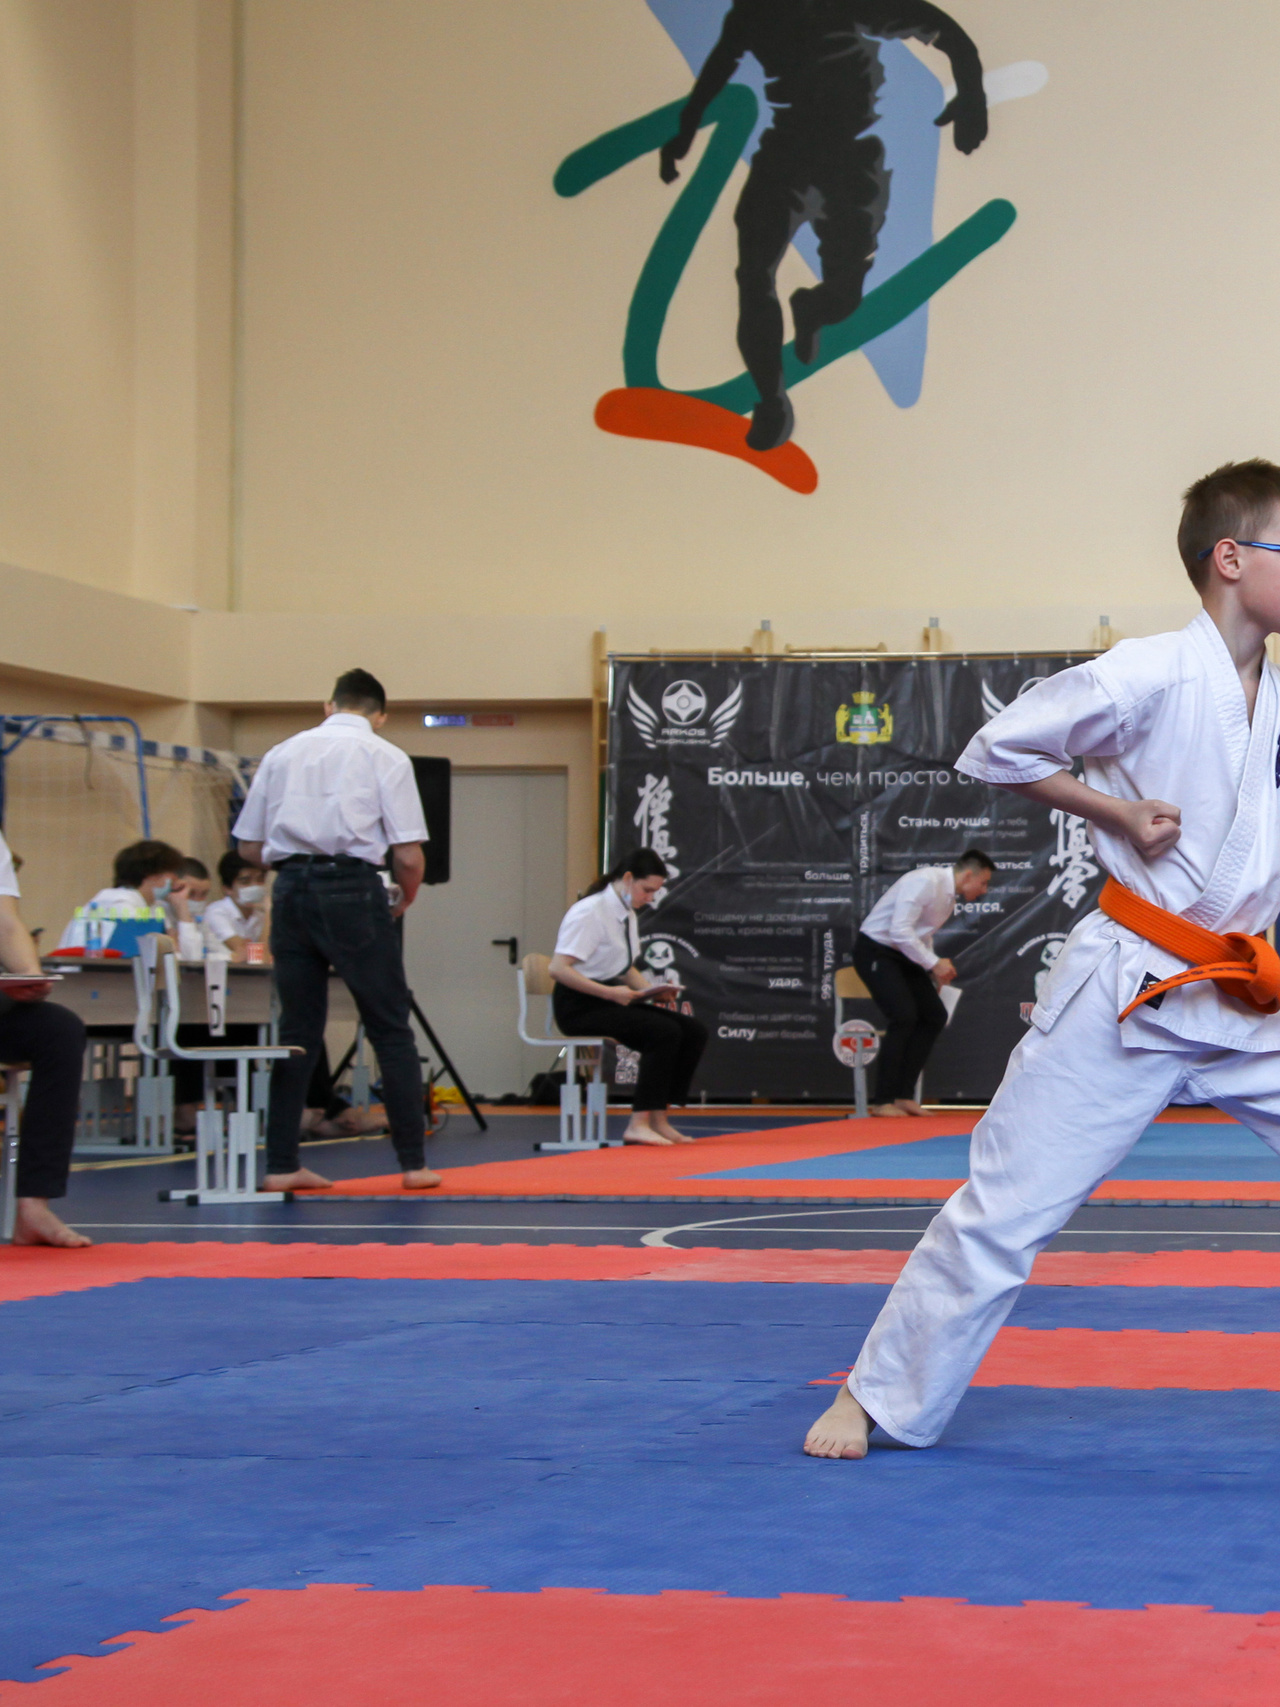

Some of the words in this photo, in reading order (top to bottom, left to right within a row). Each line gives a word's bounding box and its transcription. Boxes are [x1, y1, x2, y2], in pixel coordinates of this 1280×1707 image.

[661, 728, 707, 737] ARKOS
[708, 767, 811, 788] Больше,
[816, 771, 861, 786] чем
[868, 769, 950, 788] просто
[898, 815, 940, 828] Стань
[943, 817, 990, 829] лучше
[859, 811, 871, 875] трудиться,
[694, 911, 746, 924] Спящему
[749, 913, 763, 922] не
[765, 913, 829, 923] достанется
[823, 928, 835, 971] труда.
[768, 977, 803, 989] удар.
[820, 972, 832, 1001] 99%
[717, 1025, 757, 1041] Силу
